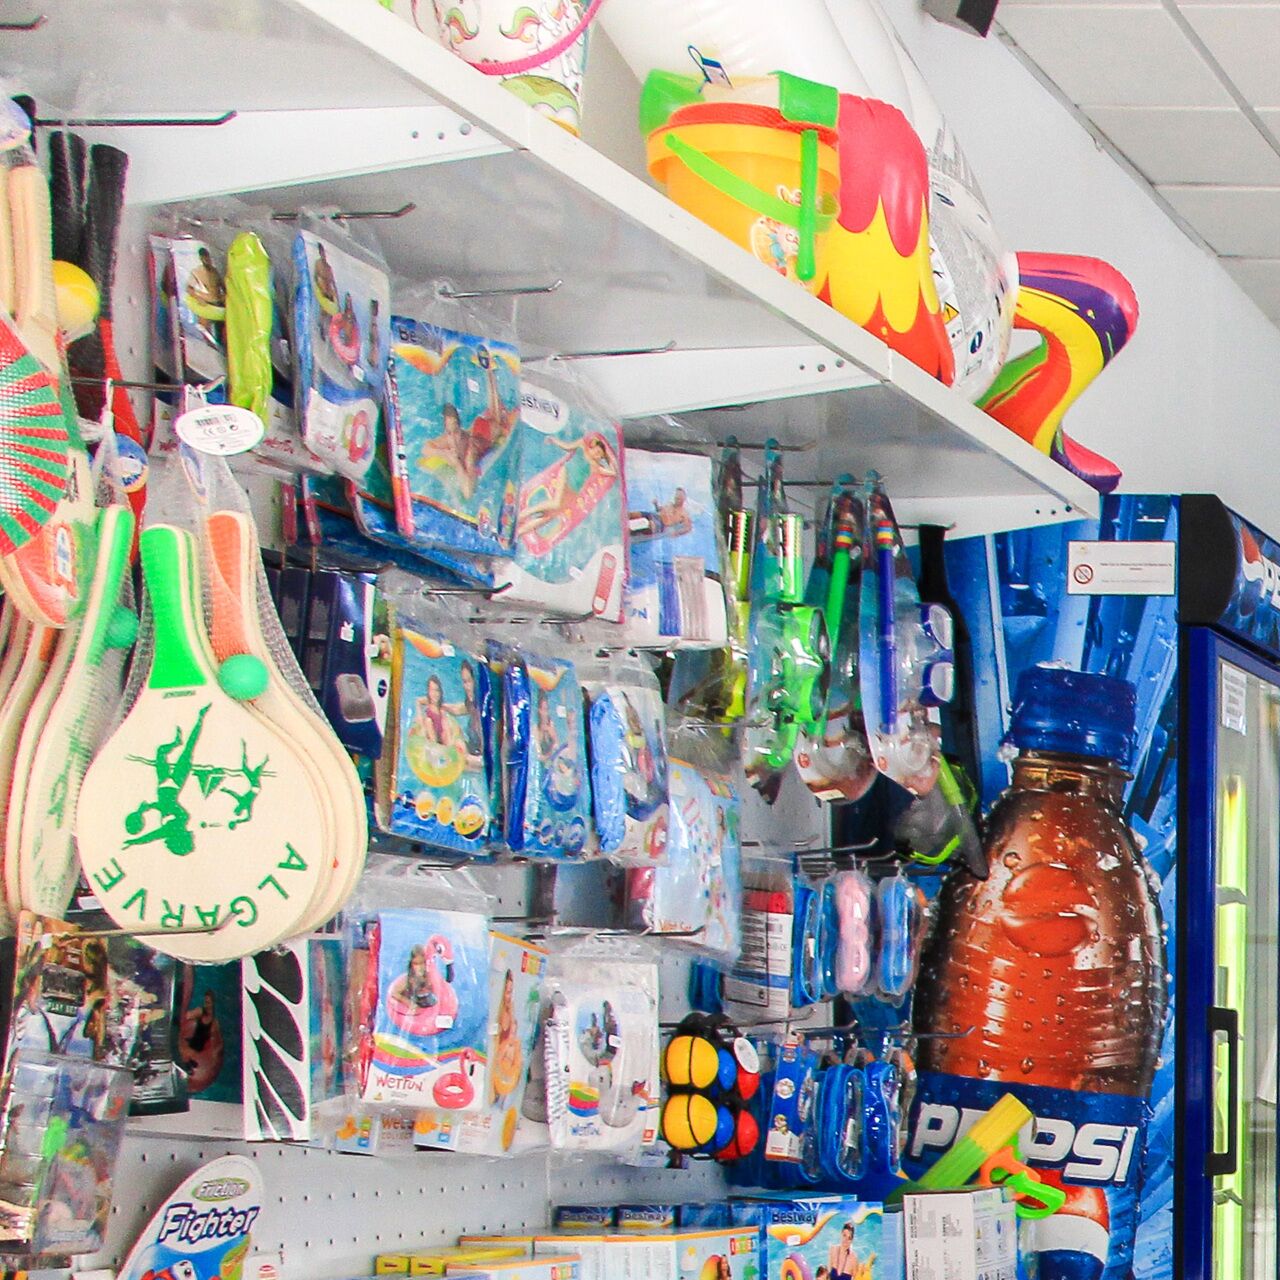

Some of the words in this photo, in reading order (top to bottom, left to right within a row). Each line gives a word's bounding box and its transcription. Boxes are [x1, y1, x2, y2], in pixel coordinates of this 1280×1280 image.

[94, 842, 308, 930] ALGARVE
[158, 1202, 260, 1243] Fighter
[771, 1210, 818, 1226] Bestway
